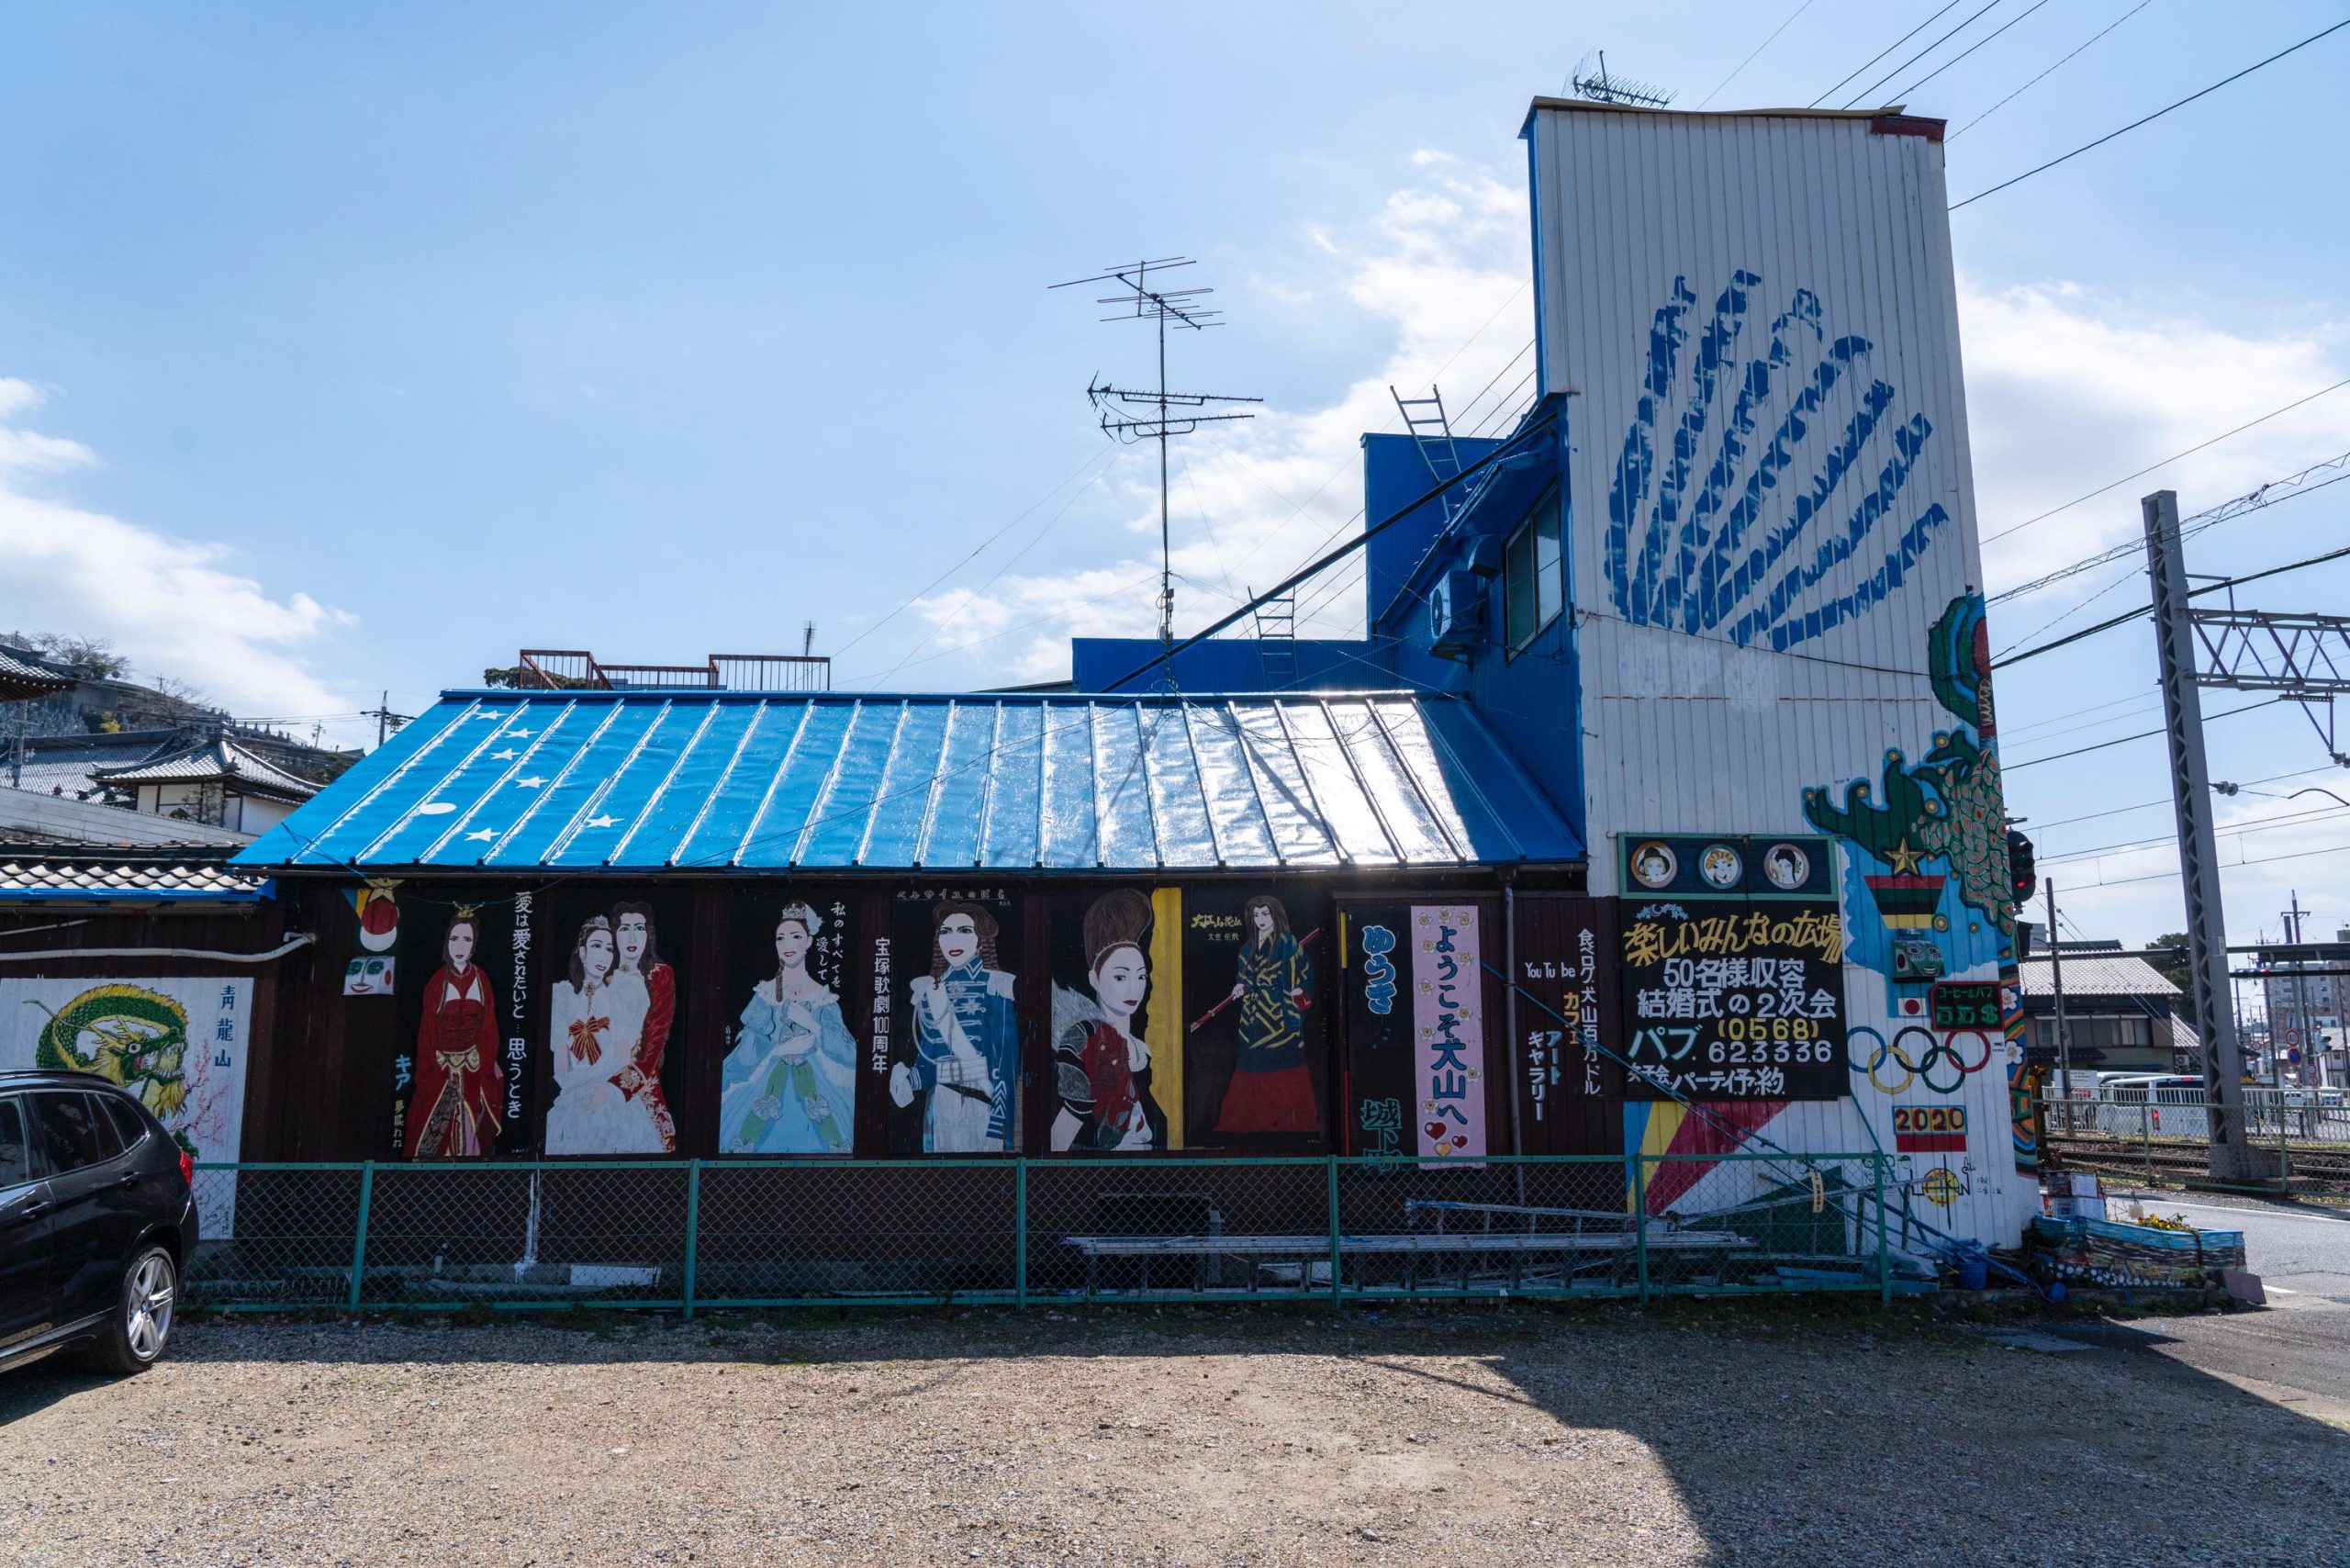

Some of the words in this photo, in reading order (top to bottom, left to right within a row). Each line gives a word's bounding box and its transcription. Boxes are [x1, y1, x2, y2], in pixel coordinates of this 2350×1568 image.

[817, 936, 830, 980] 愛して
[830, 902, 846, 988] 私のすべてを
[1623, 910, 1842, 967] 楽しいみんなの広場
[1362, 925, 1396, 1014] ゆうき
[1663, 958, 1807, 989] 50名様収容
[214, 985, 235, 1068] 青龍山
[872, 937, 890, 1075] 宝塚歌劇100周年
[1430, 925, 1468, 1126] ようこそ犬山へ
[1563, 991, 1580, 1045] カフェ
[1637, 988, 1837, 1019] 結婚式の2次会
[1718, 1017, 1819, 1041] (0568)
[1528, 1030, 1547, 1121] ギャラリー
[1546, 1030, 1562, 1085] アート
[1895, 1107, 1965, 1132] 2020
